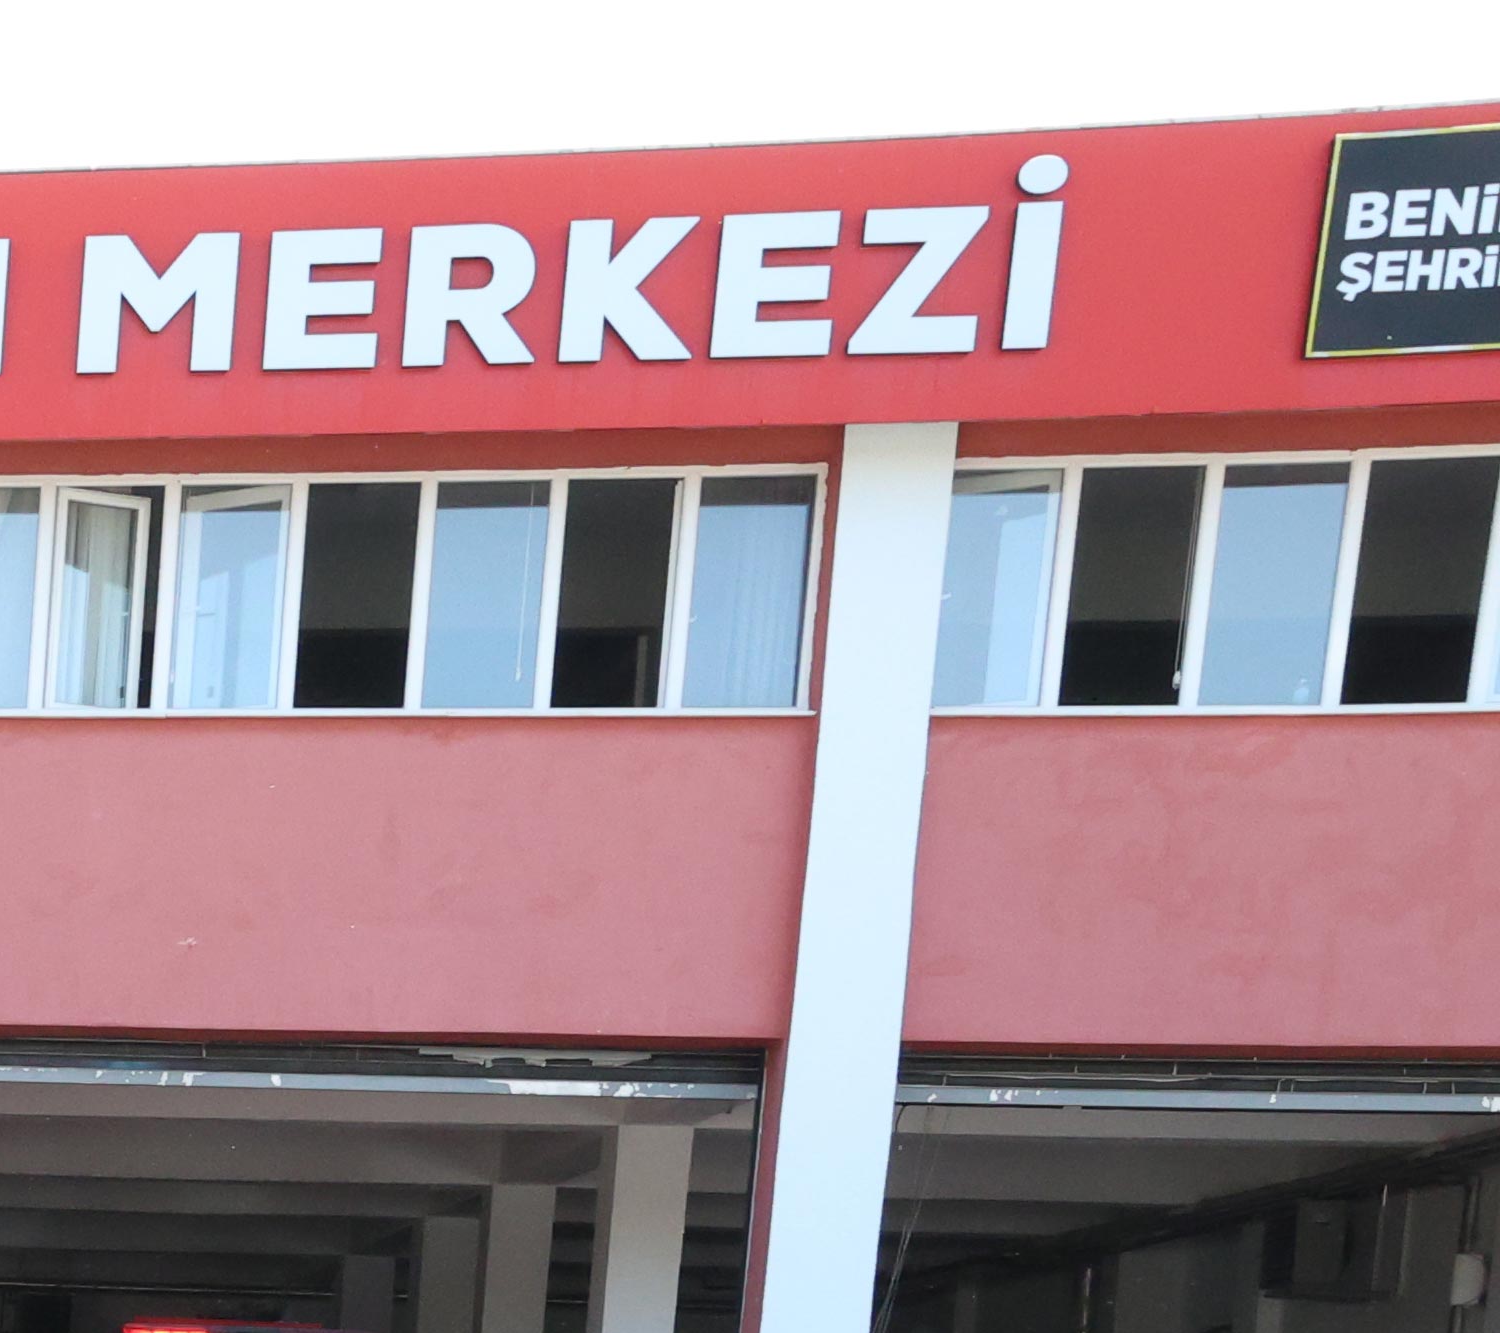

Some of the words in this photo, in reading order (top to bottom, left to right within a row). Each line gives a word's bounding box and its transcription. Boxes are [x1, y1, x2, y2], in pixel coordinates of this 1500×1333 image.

[1344, 182, 1500, 241] BENİ
[76, 154, 1069, 375] MERKEZİ
[1336, 244, 1500, 302] ŞEHRİ
